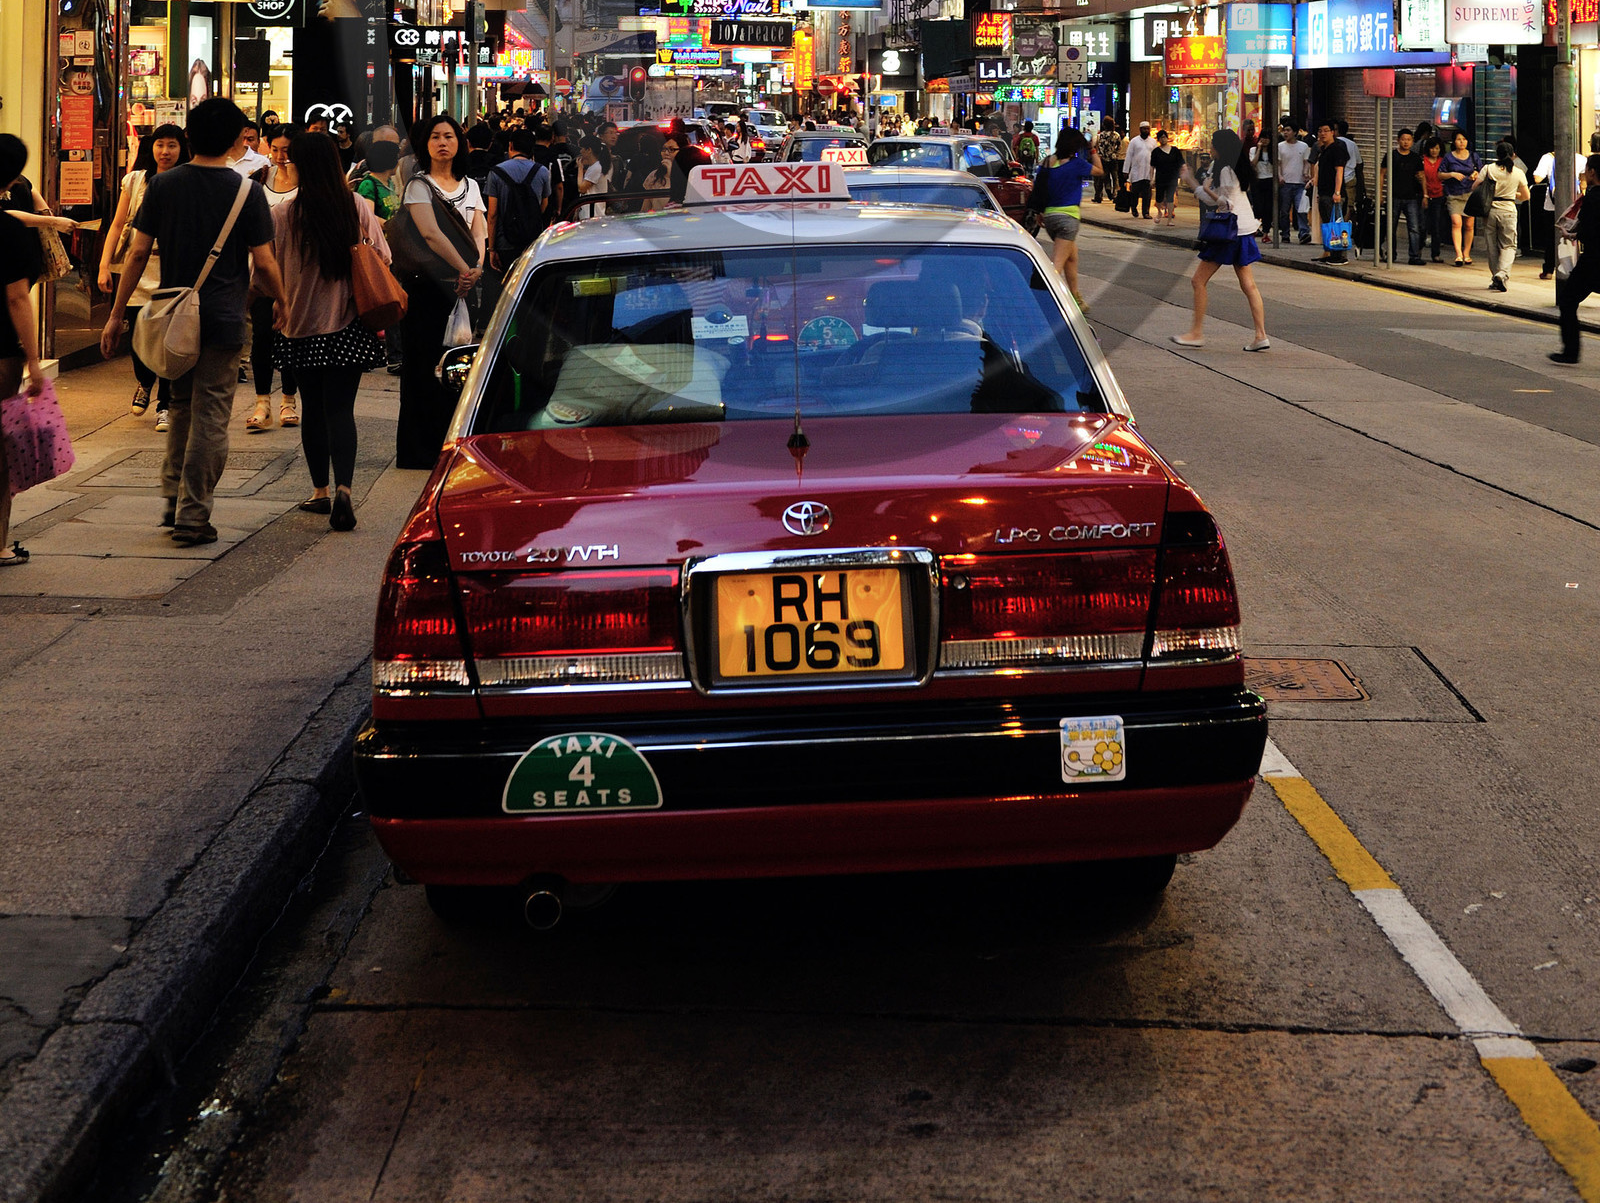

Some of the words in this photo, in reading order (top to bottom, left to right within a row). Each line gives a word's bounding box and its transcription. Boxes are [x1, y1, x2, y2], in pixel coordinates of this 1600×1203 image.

[257, 1, 285, 11] SHOP
[1454, 6, 1520, 22] SUPREME
[1332, 12, 1388, 56] 富邦銀行
[1169, 42, 1224, 61] 許留山
[827, 150, 864, 163] TAXI
[701, 165, 831, 197] TAXI
[808, 318, 844, 331] TAXI
[823, 326, 832, 339] 5
[994, 527, 1041, 544] LPG
[1049, 522, 1157, 541] COMFORT
[460, 551, 517, 563] TOYOTA
[526, 547, 558, 563] 2.0
[772, 572, 849, 622] RH
[743, 620, 881, 673] 1069
[547, 736, 619, 759] TAXI
[568, 755, 595, 788] 4
[533, 788, 631, 808] SEATS
